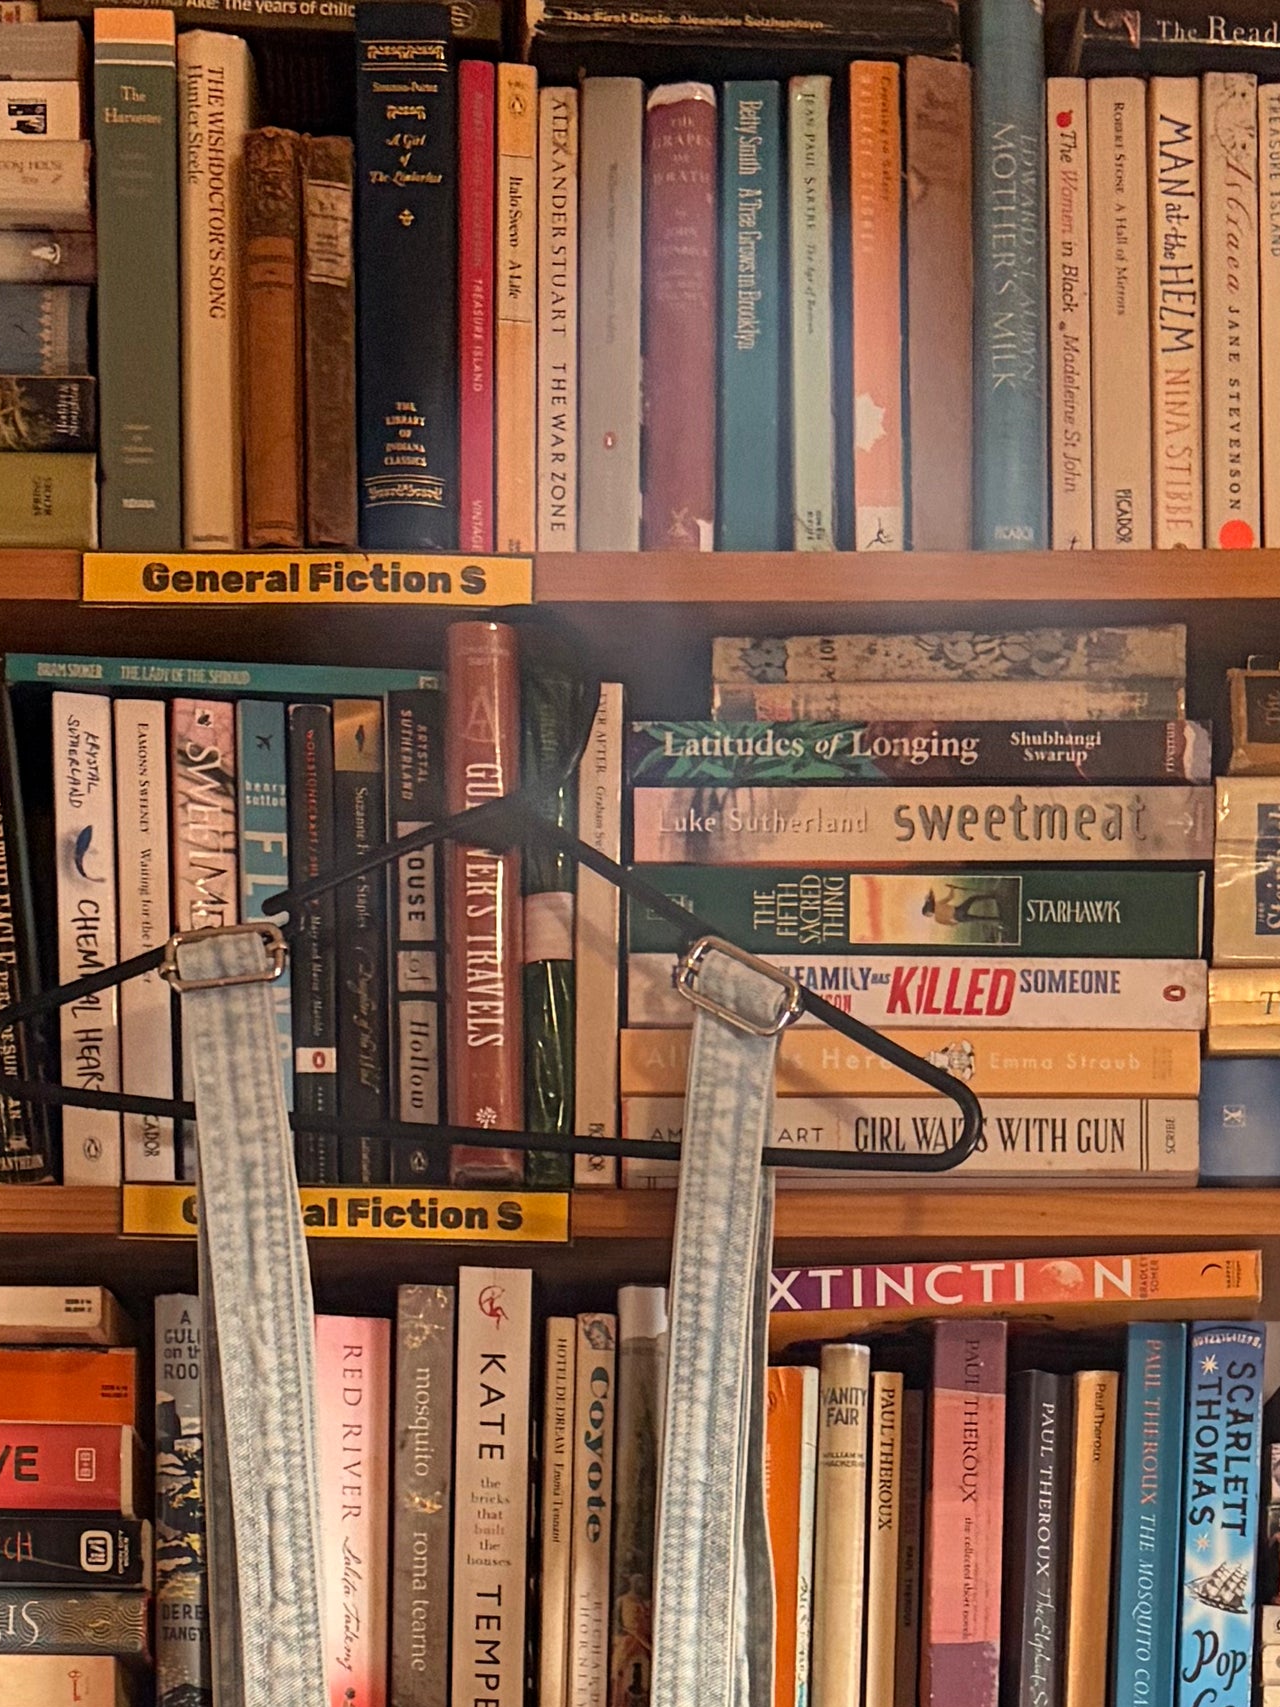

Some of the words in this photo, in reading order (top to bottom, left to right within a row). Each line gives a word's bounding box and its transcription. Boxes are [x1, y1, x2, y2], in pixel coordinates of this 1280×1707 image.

[551, 99, 570, 241] ALEXANDER
[991, 122, 1020, 297] MOTHER'S
[551, 245, 570, 337] STUART
[991, 306, 1019, 390] MILK
[551, 362, 570, 404] THE
[551, 411, 570, 464] WAR
[551, 470, 570, 534] ZONE
[143, 562, 299, 594] General
[309, 562, 451, 594] Fiction
[461, 566, 486, 594] S
[663, 731, 804, 759] Latitudes
[815, 732, 844, 756] of
[852, 733, 979, 765] Longing
[895, 795, 1147, 842] sweetmeat
[1026, 899, 1121, 924] STARHAWK
[886, 965, 1016, 1017] KILLED
[1020, 969, 1120, 994] SOMEONE
[479, 1352, 506, 1462] KATE
